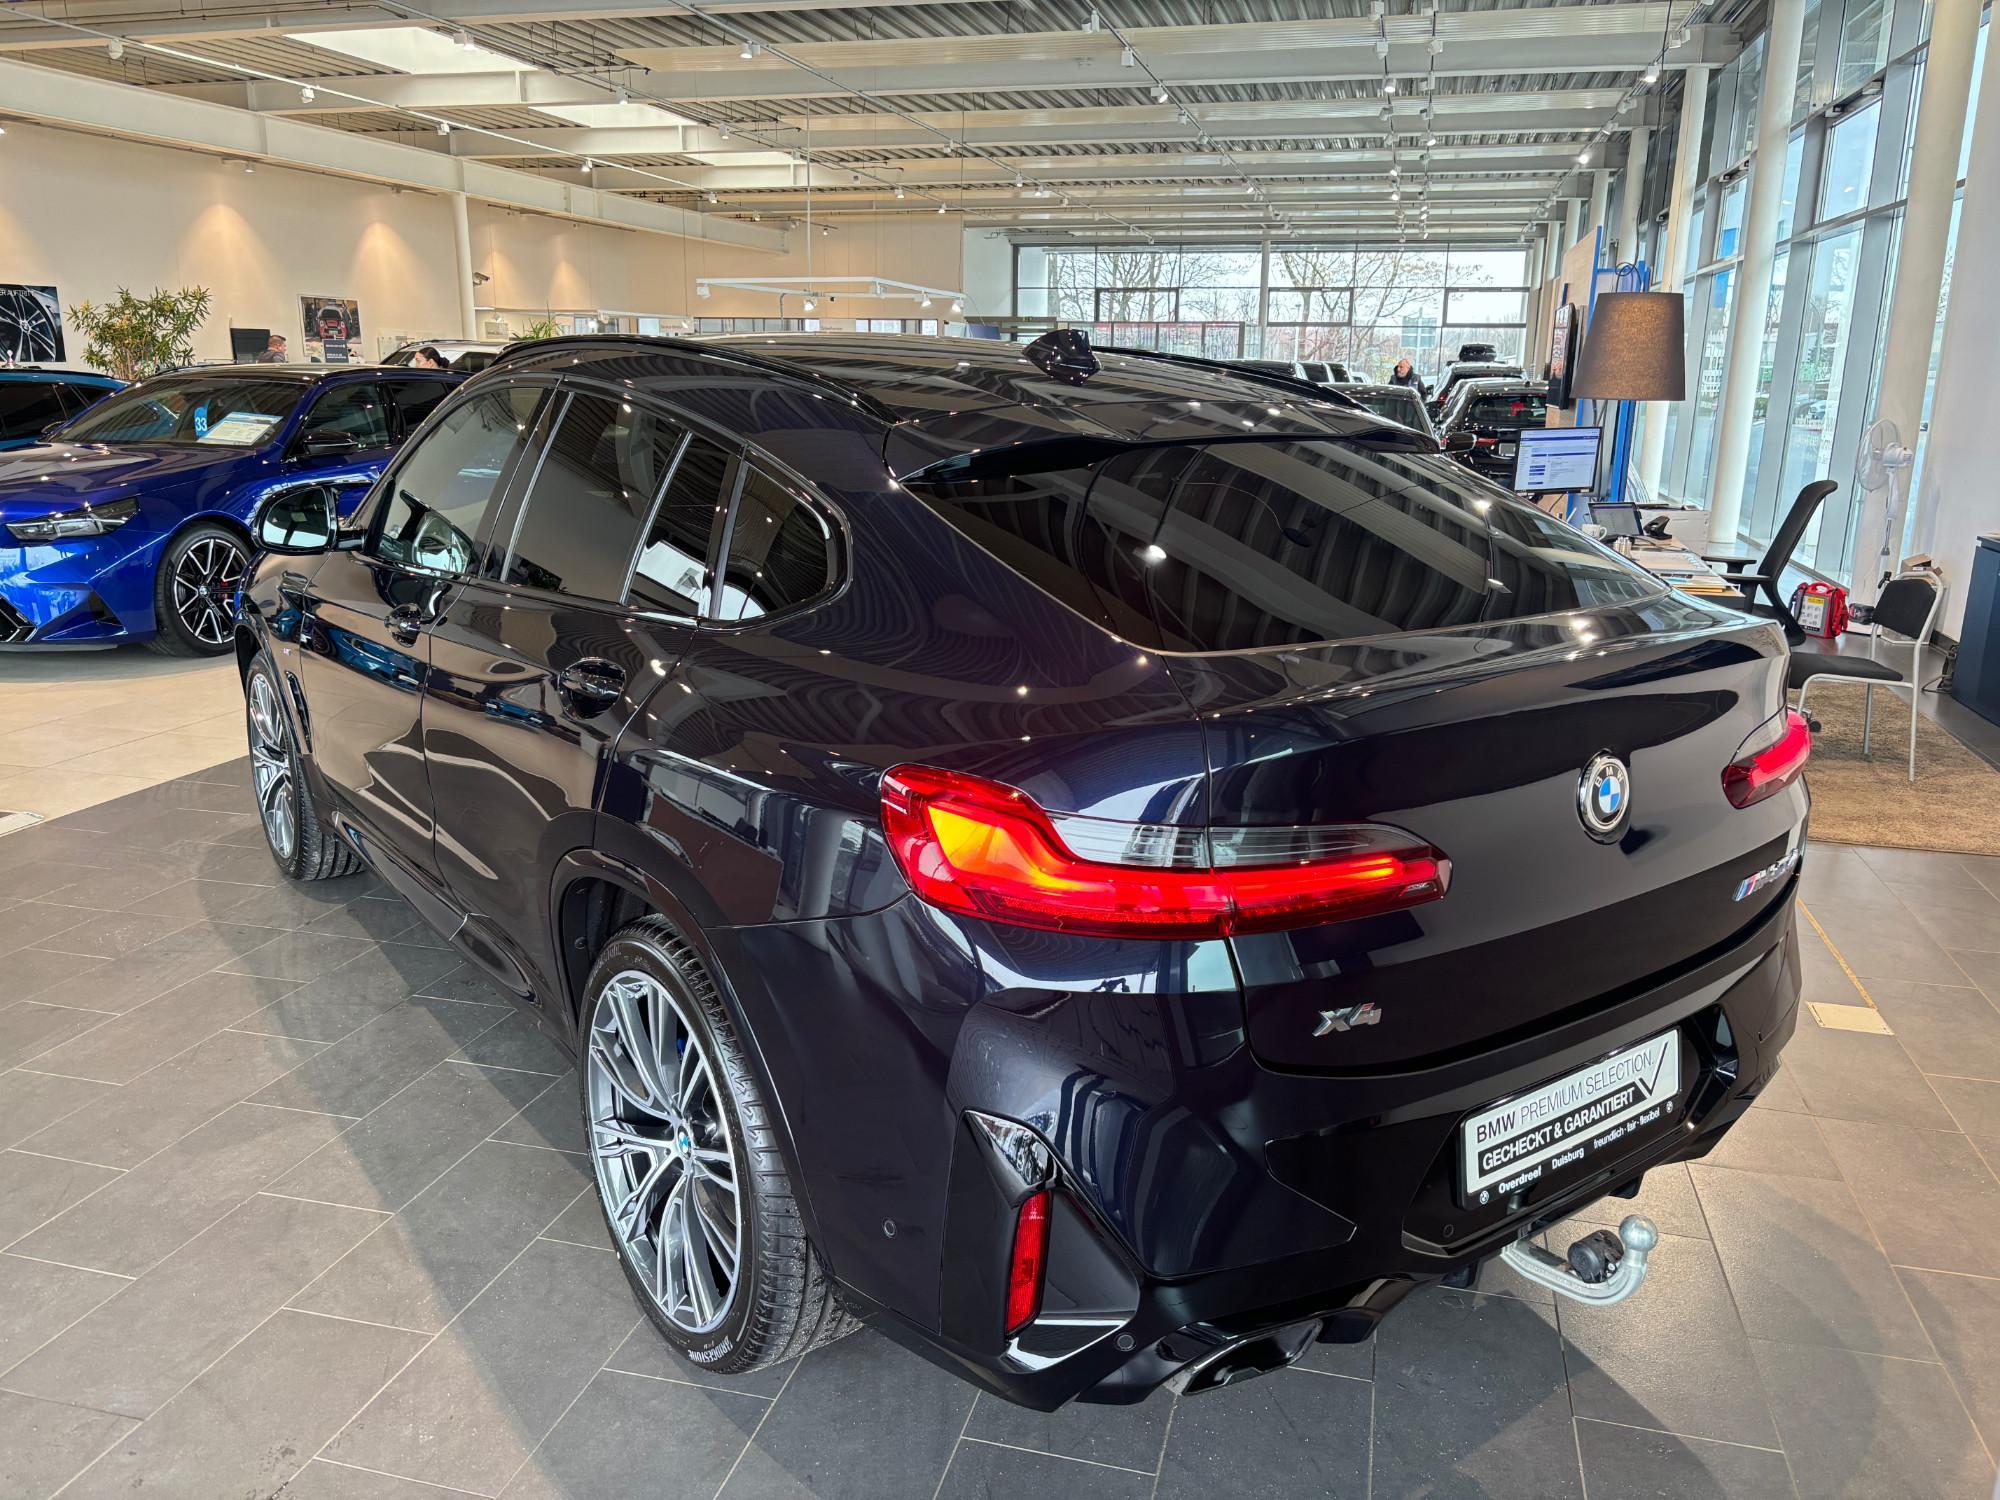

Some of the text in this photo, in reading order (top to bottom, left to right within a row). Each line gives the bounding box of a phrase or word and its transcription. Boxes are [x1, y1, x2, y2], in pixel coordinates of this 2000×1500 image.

[195, 417, 208, 431] 33
[1595, 766, 1625, 788] BMW
[1312, 1002, 1382, 1037] X4
[1477, 1111, 1516, 1143] BMW
[1521, 1082, 1583, 1125] PREMIUM
[1483, 1087, 1635, 1170] GECHECKT & GARANTIERT
[1552, 1147, 1584, 1170] Duisburg
[688, 1335, 733, 1363] BRIDGESTONE
